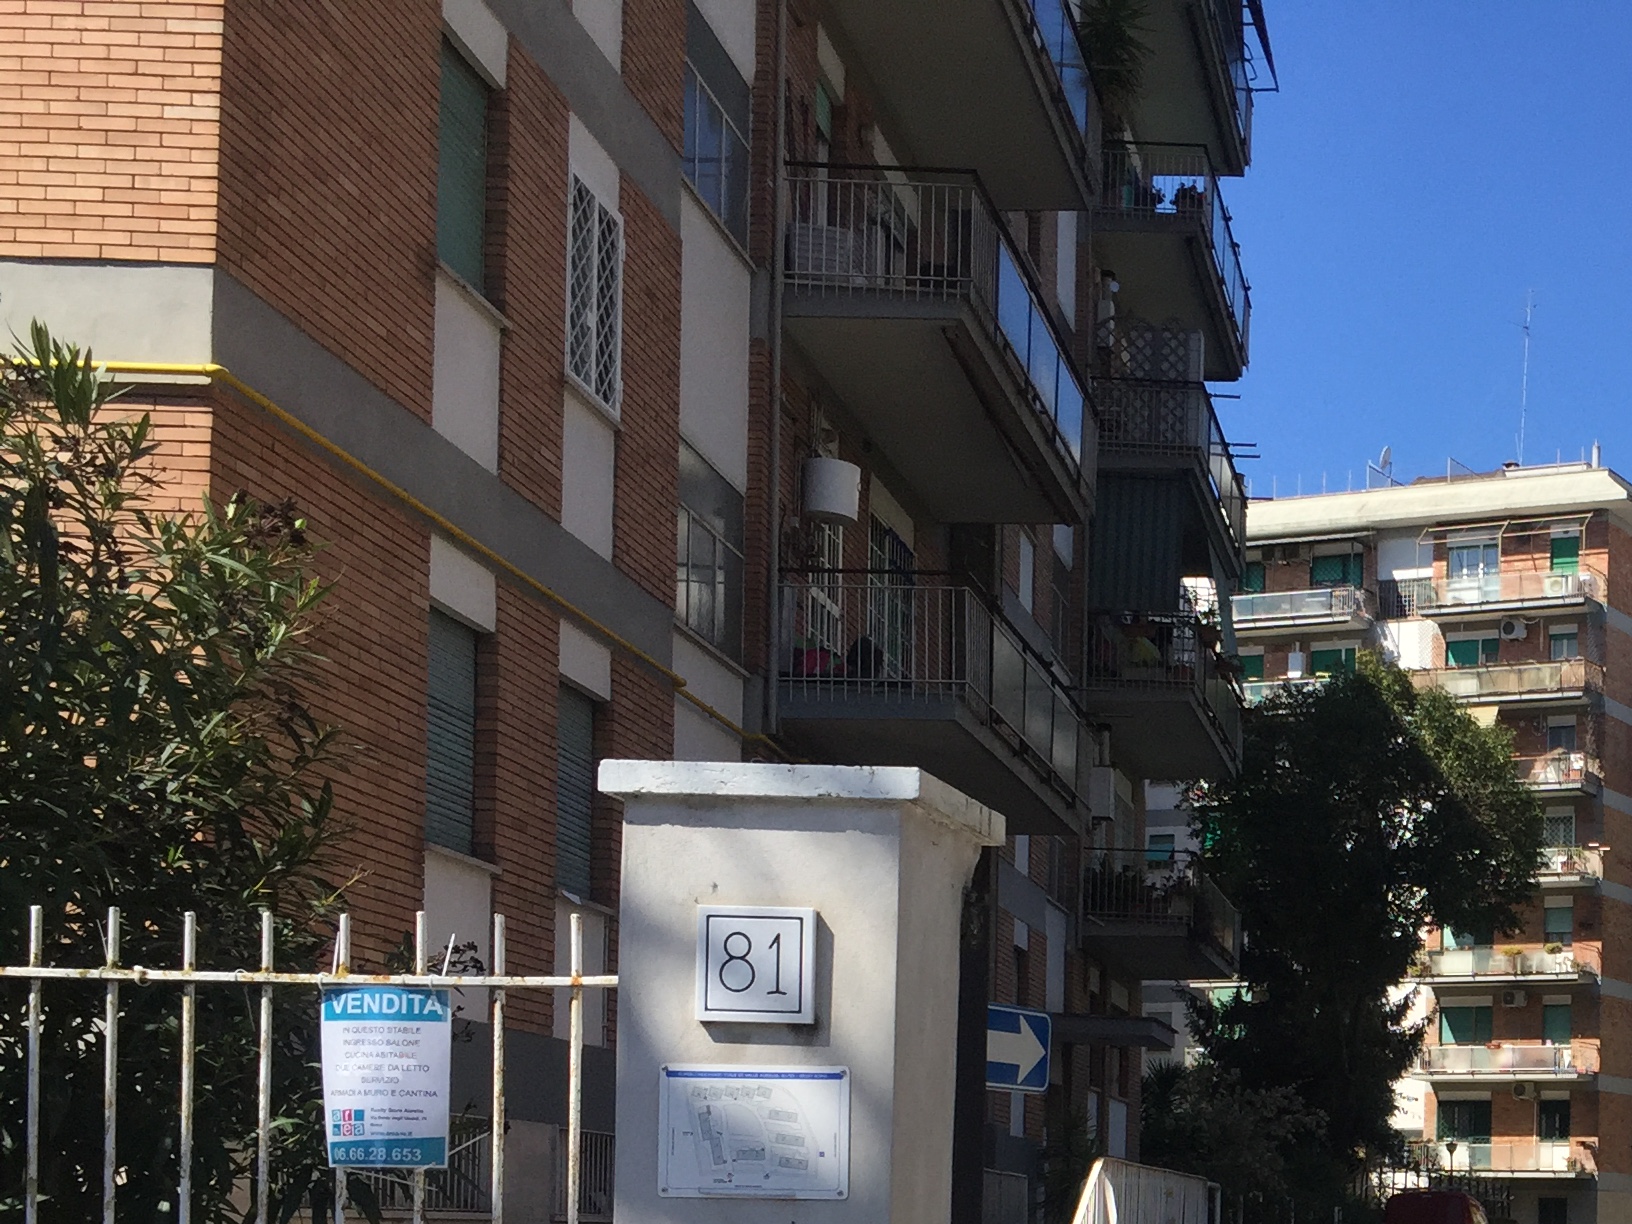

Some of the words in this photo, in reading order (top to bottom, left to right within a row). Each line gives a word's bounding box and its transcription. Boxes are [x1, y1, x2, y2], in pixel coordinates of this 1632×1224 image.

[719, 932, 787, 996] 81
[332, 993, 444, 1015] VENDITA
[402, 1064, 430, 1072] LETTO
[398, 1090, 438, 1098] CANTINA
[334, 1147, 422, 1160] 06.66.28.653
